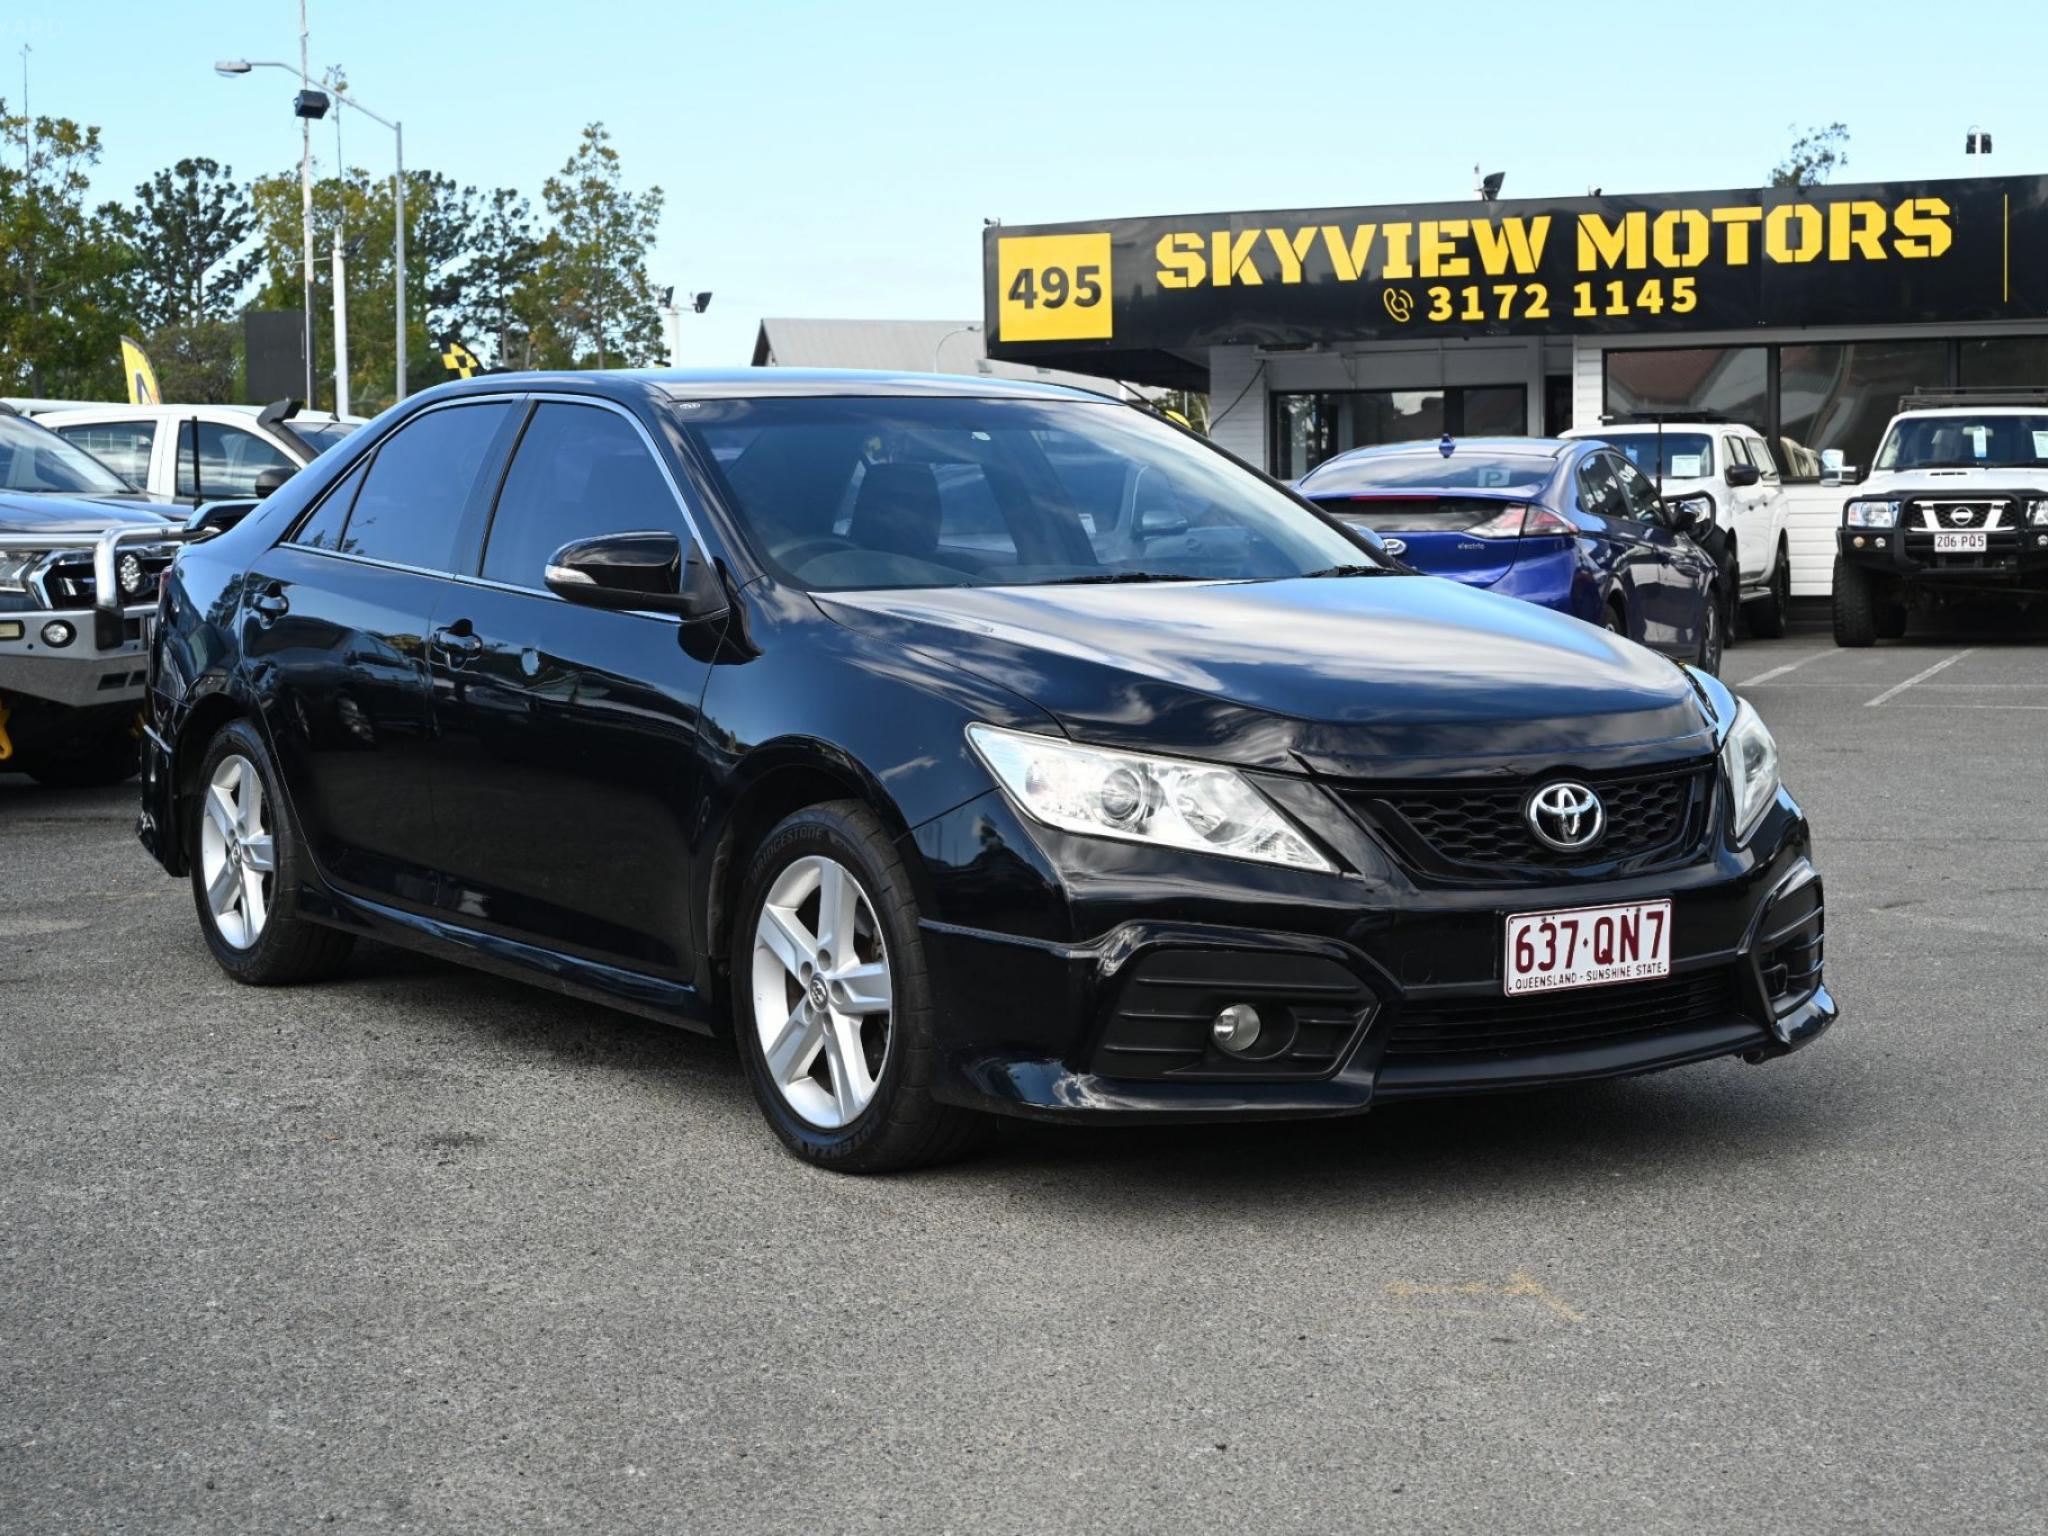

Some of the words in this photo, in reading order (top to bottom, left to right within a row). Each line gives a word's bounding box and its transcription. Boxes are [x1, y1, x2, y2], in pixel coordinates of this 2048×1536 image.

[1156, 216, 1551, 288] SKYVIEW
[1577, 198, 1952, 271] MOTORS
[1008, 265, 1102, 309] 495
[1427, 283, 1549, 322] 3172
[1573, 277, 1697, 316] 1145
[1515, 972, 1576, 990] QUEENSLAND
[1586, 965, 1631, 981] SUNSHINE
[1636, 962, 1662, 976] STATE
